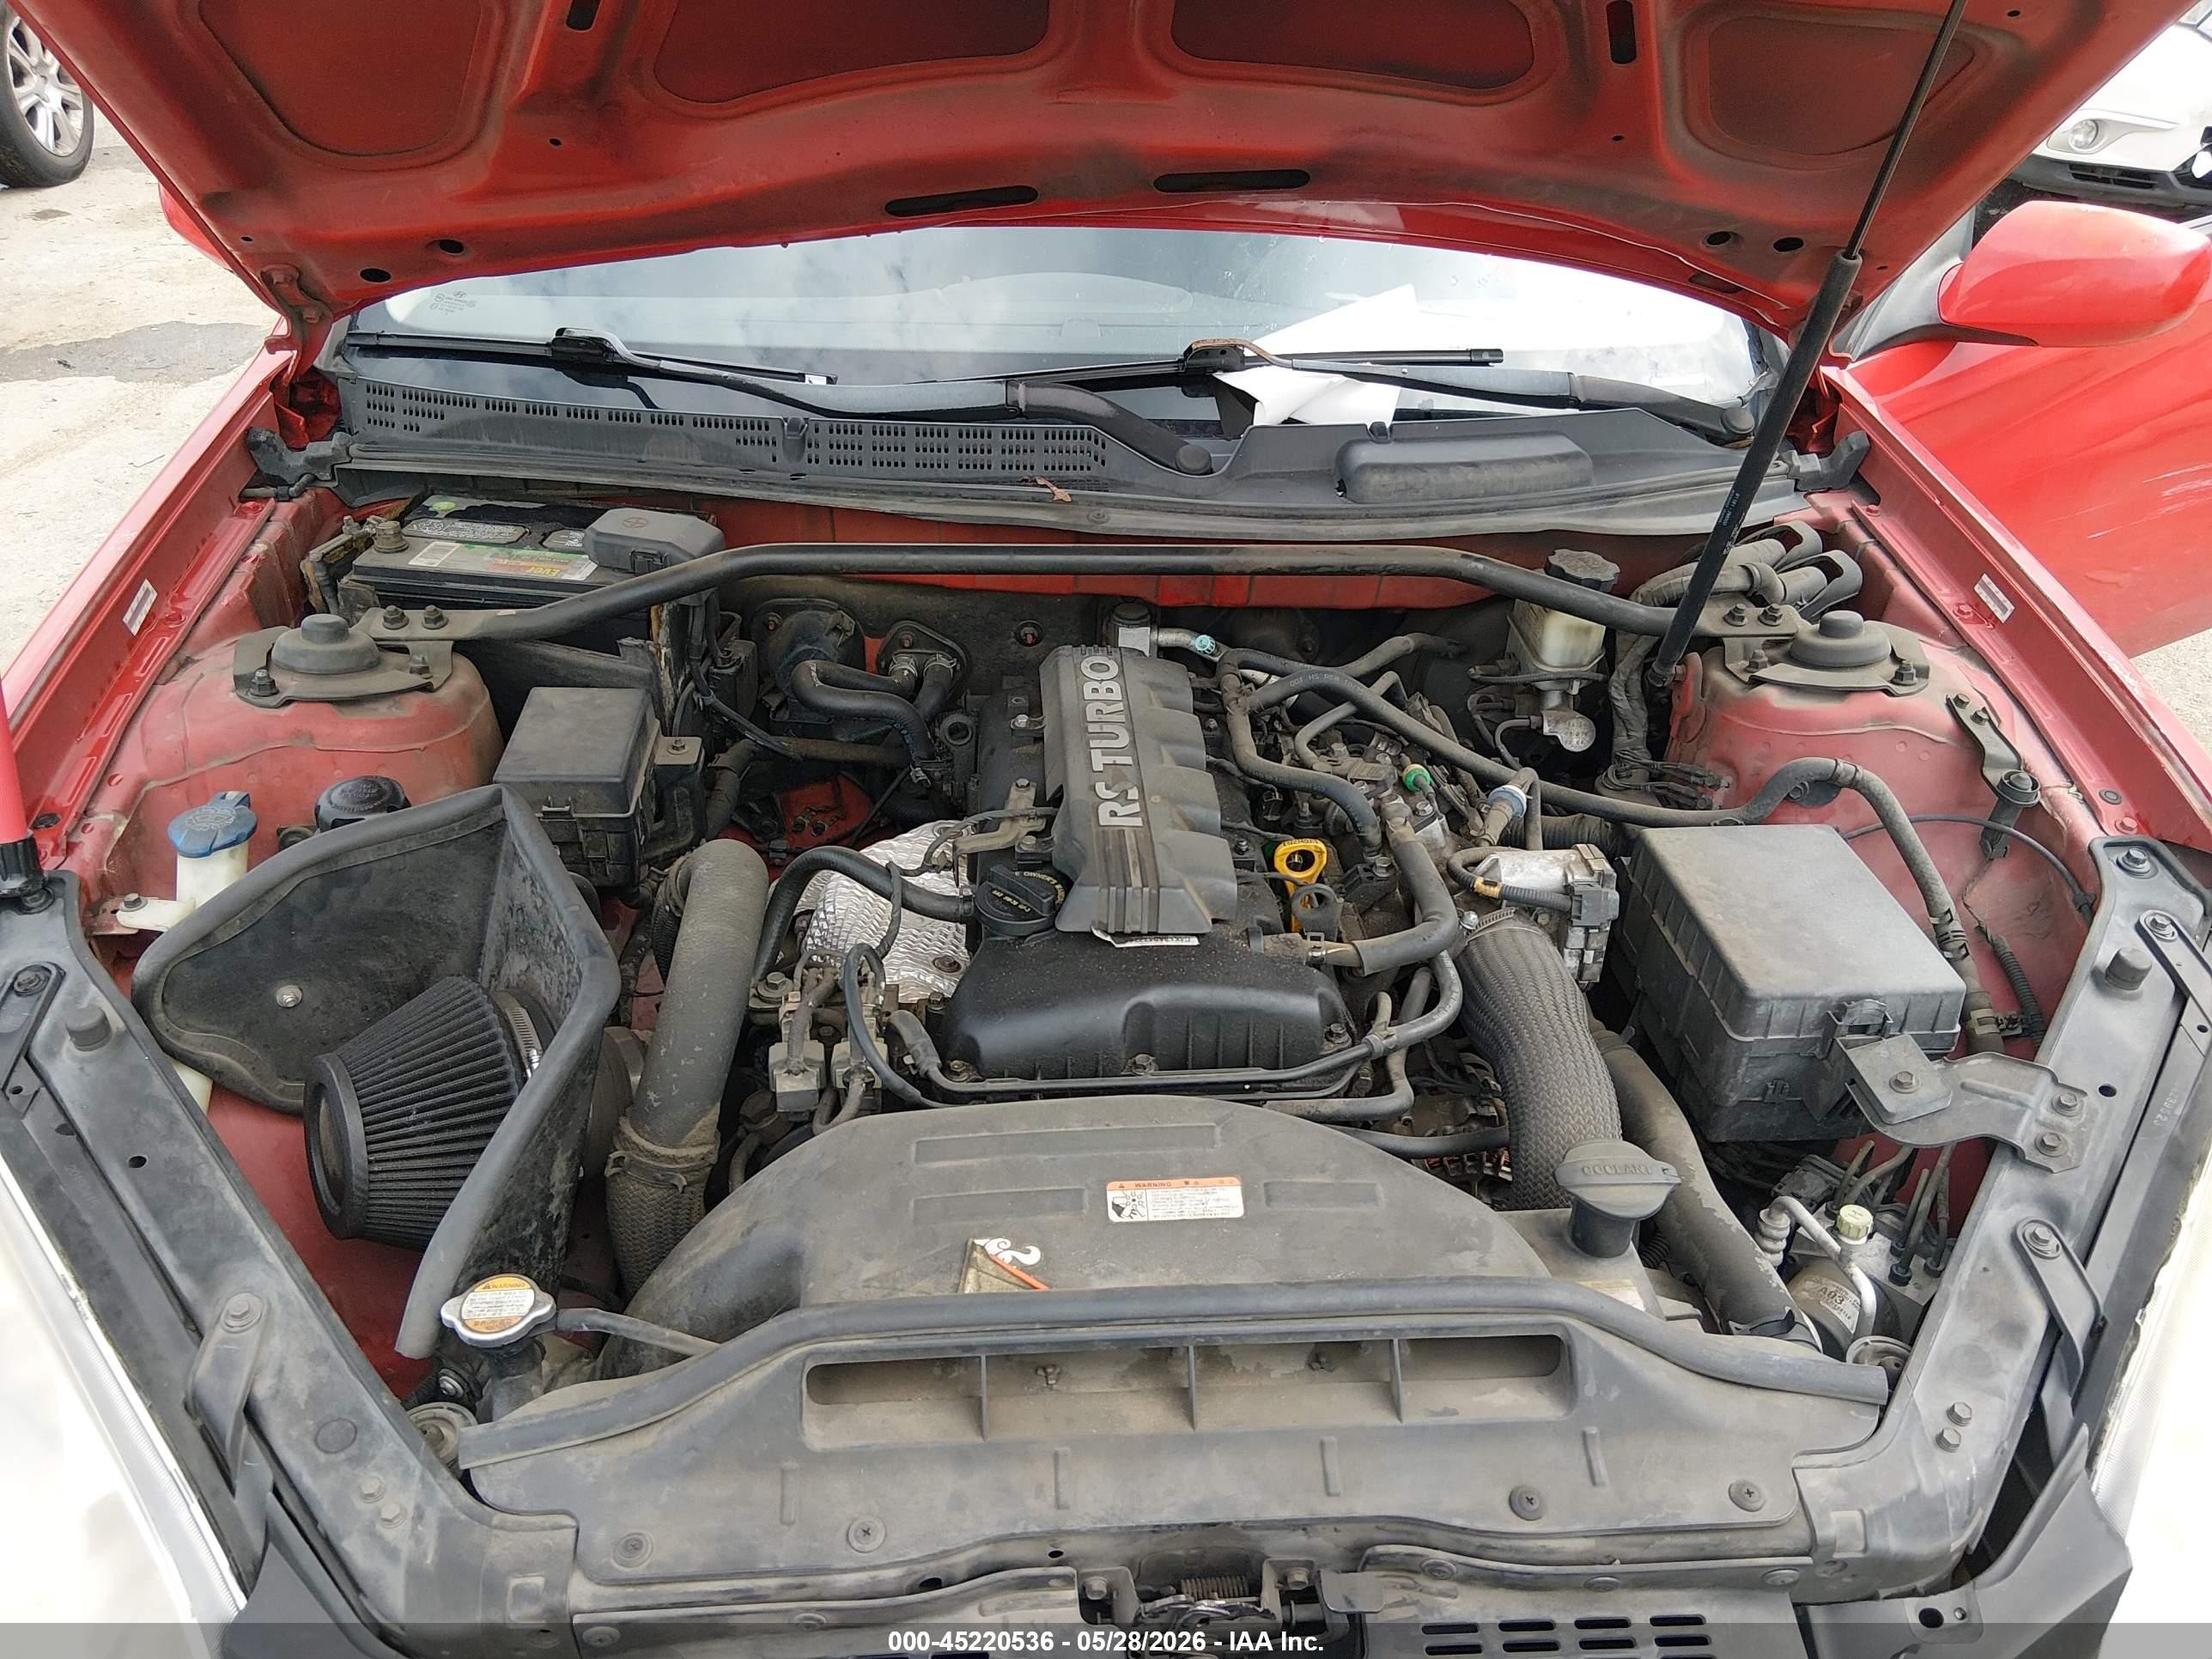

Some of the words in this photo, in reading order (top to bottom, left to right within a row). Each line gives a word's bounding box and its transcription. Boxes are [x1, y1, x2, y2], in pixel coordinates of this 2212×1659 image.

[1081, 655, 1133, 772] TURBO
[1095, 781, 1143, 827] RS
[1582, 1164, 1651, 1176] COOLANT
[1819, 1286, 1844, 1304] A03
